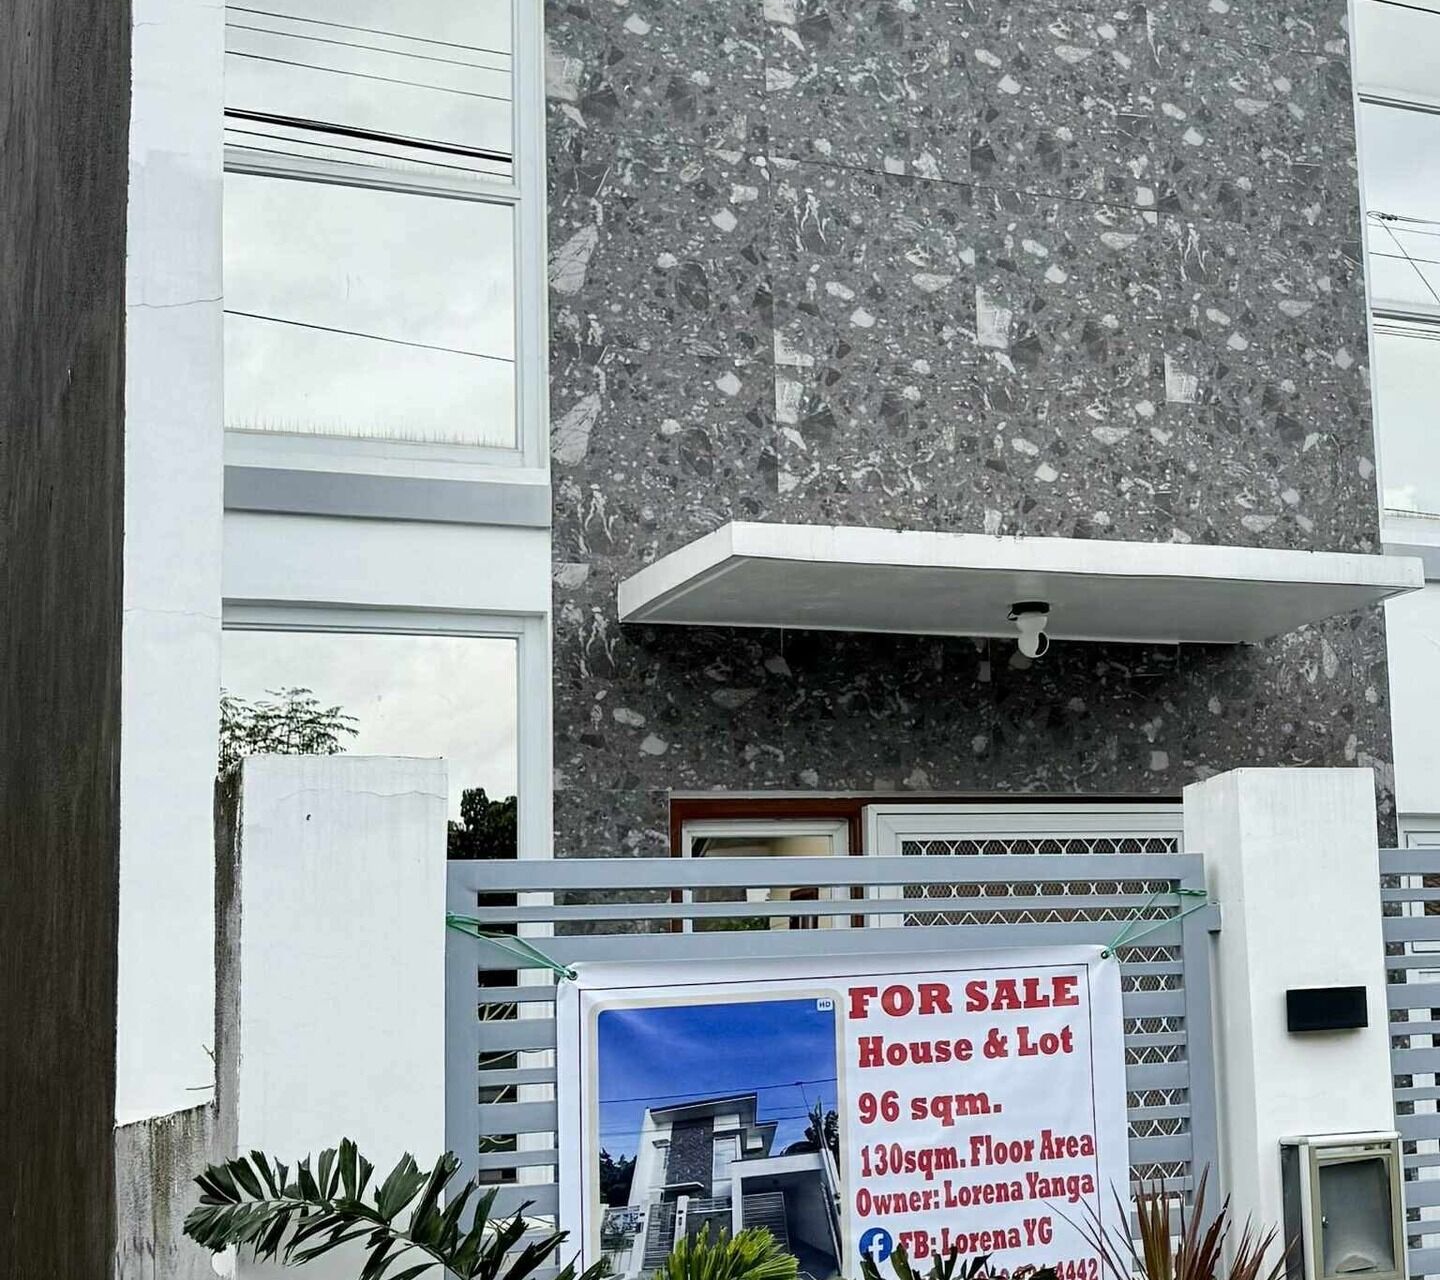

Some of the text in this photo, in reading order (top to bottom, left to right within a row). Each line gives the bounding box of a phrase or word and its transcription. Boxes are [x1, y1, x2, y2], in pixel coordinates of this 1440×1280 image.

[848, 975, 1080, 1020] FOR SALE
[858, 1024, 1073, 1068] House & Lot
[858, 1090, 1003, 1127] 96 sqm.
[861, 1129, 1095, 1180] 130sqm. Floor Area
[856, 1171, 1095, 1217] Owner: Lorena Yanga
[899, 1216, 1053, 1259] FB: Lorena YG
